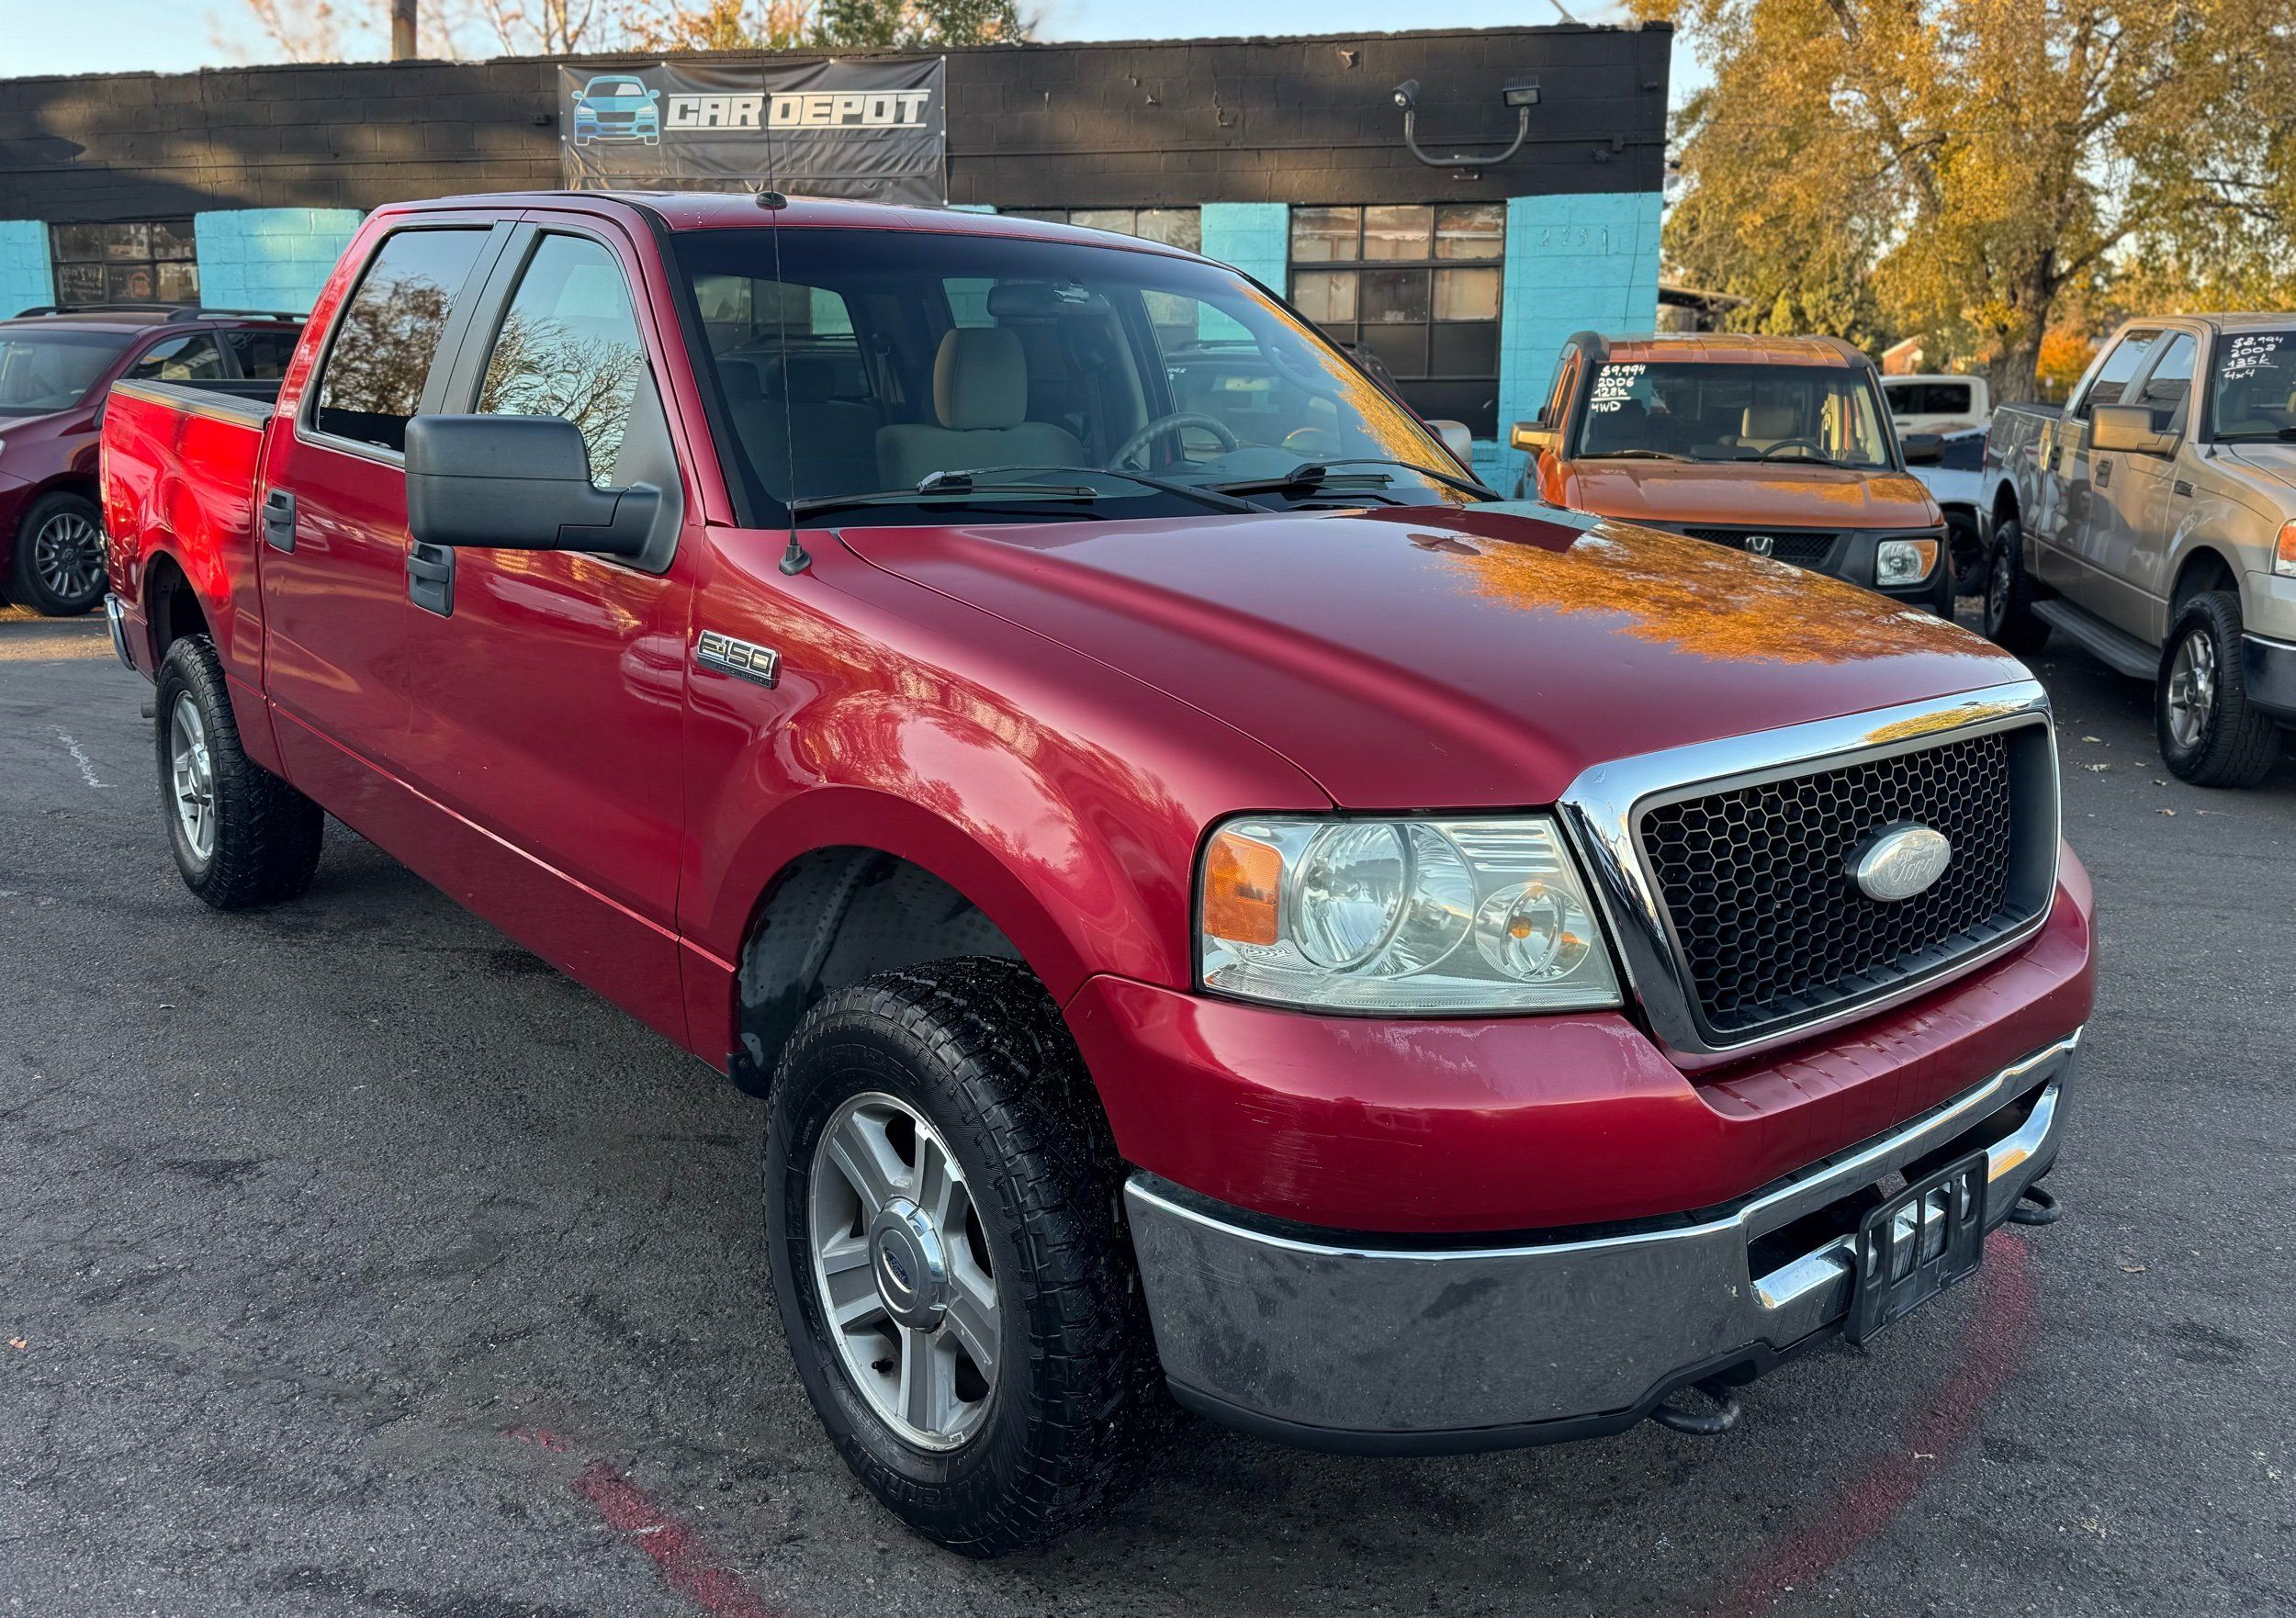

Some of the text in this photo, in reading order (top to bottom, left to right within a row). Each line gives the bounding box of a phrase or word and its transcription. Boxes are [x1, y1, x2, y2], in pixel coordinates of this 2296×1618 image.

[667, 93, 929, 127] CAR DEPOT
[2230, 343, 2277, 358] 2008
[2224, 369, 2255, 379] 4x4
[1597, 376, 1635, 388] 2006
[1591, 401, 1621, 412] 4WD
